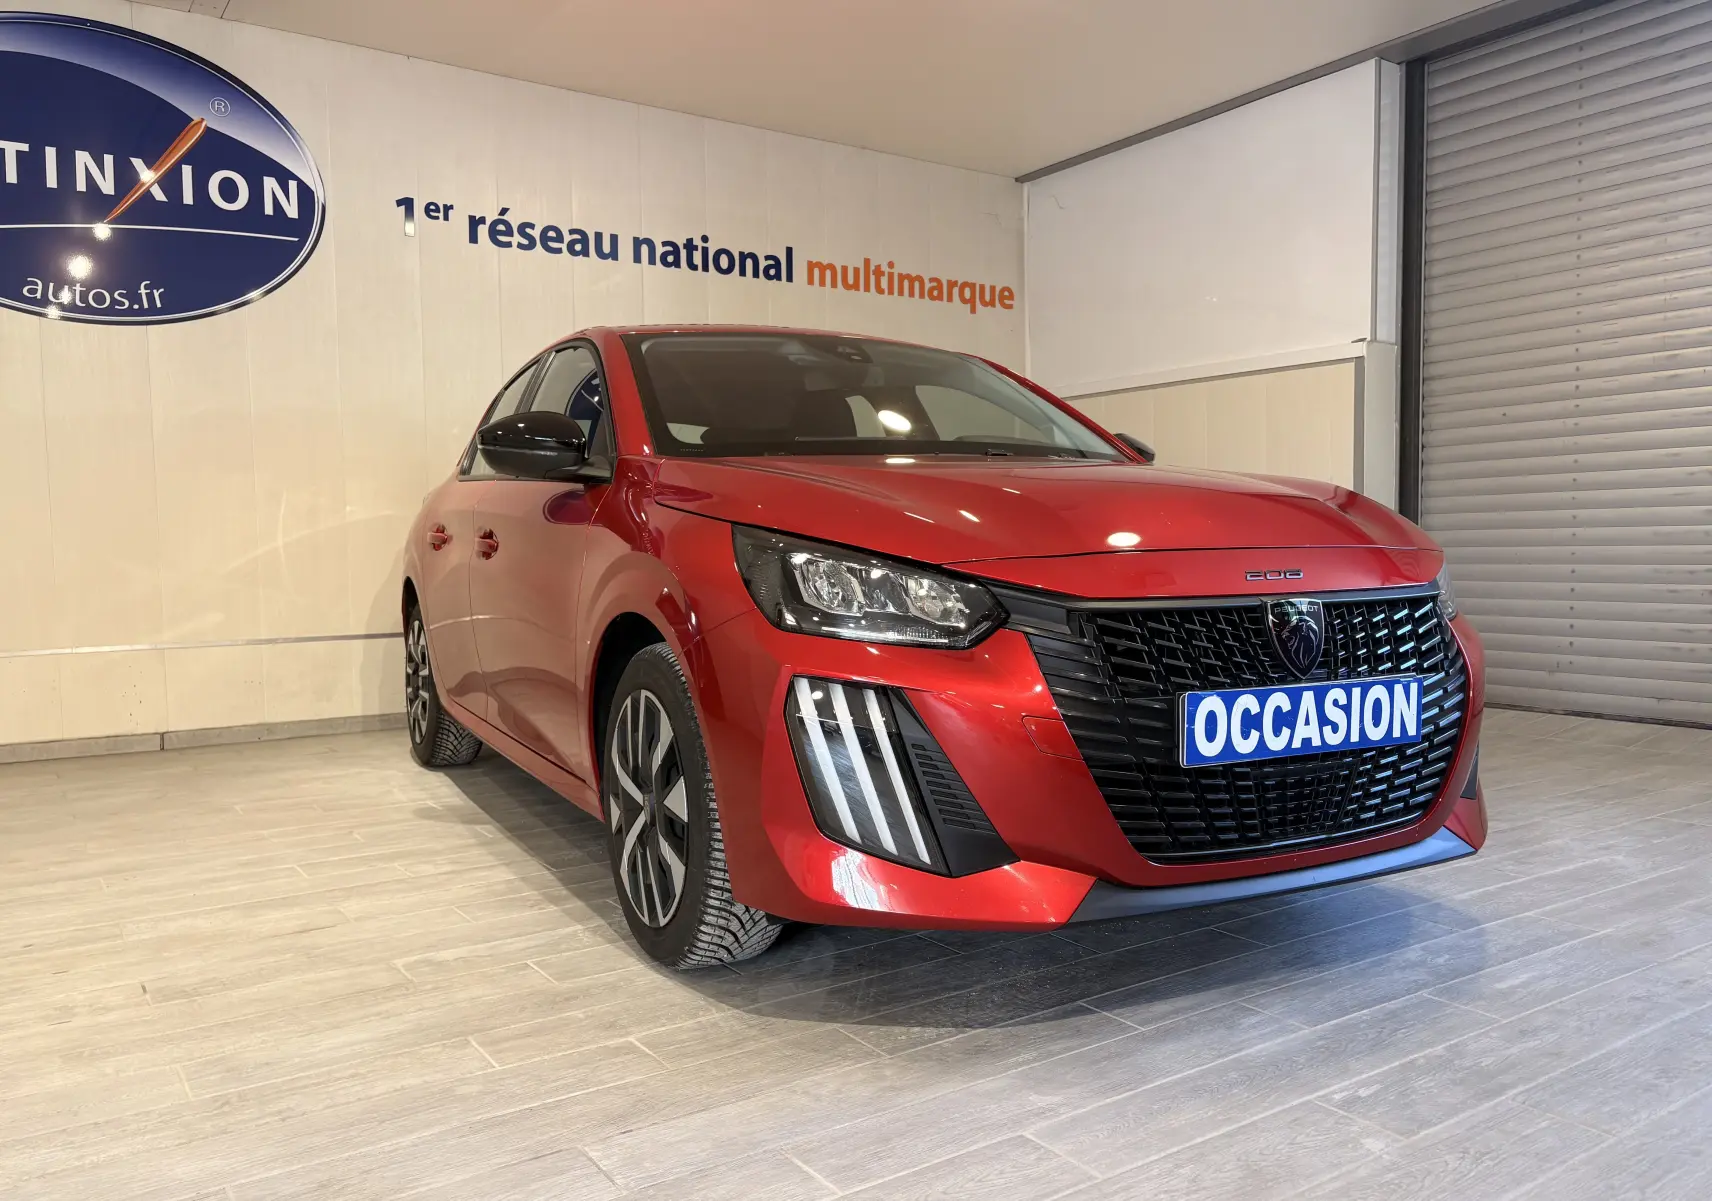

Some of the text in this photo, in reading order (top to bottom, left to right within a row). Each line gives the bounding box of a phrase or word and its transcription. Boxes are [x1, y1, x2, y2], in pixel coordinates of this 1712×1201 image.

[468, 207, 619, 262] réseau
[632, 234, 794, 283] national
[806, 257, 1015, 315] multimarque
[22, 277, 165, 310] autos.fr
[1245, 569, 1304, 581] 208
[1194, 682, 1418, 757] OCCASION
